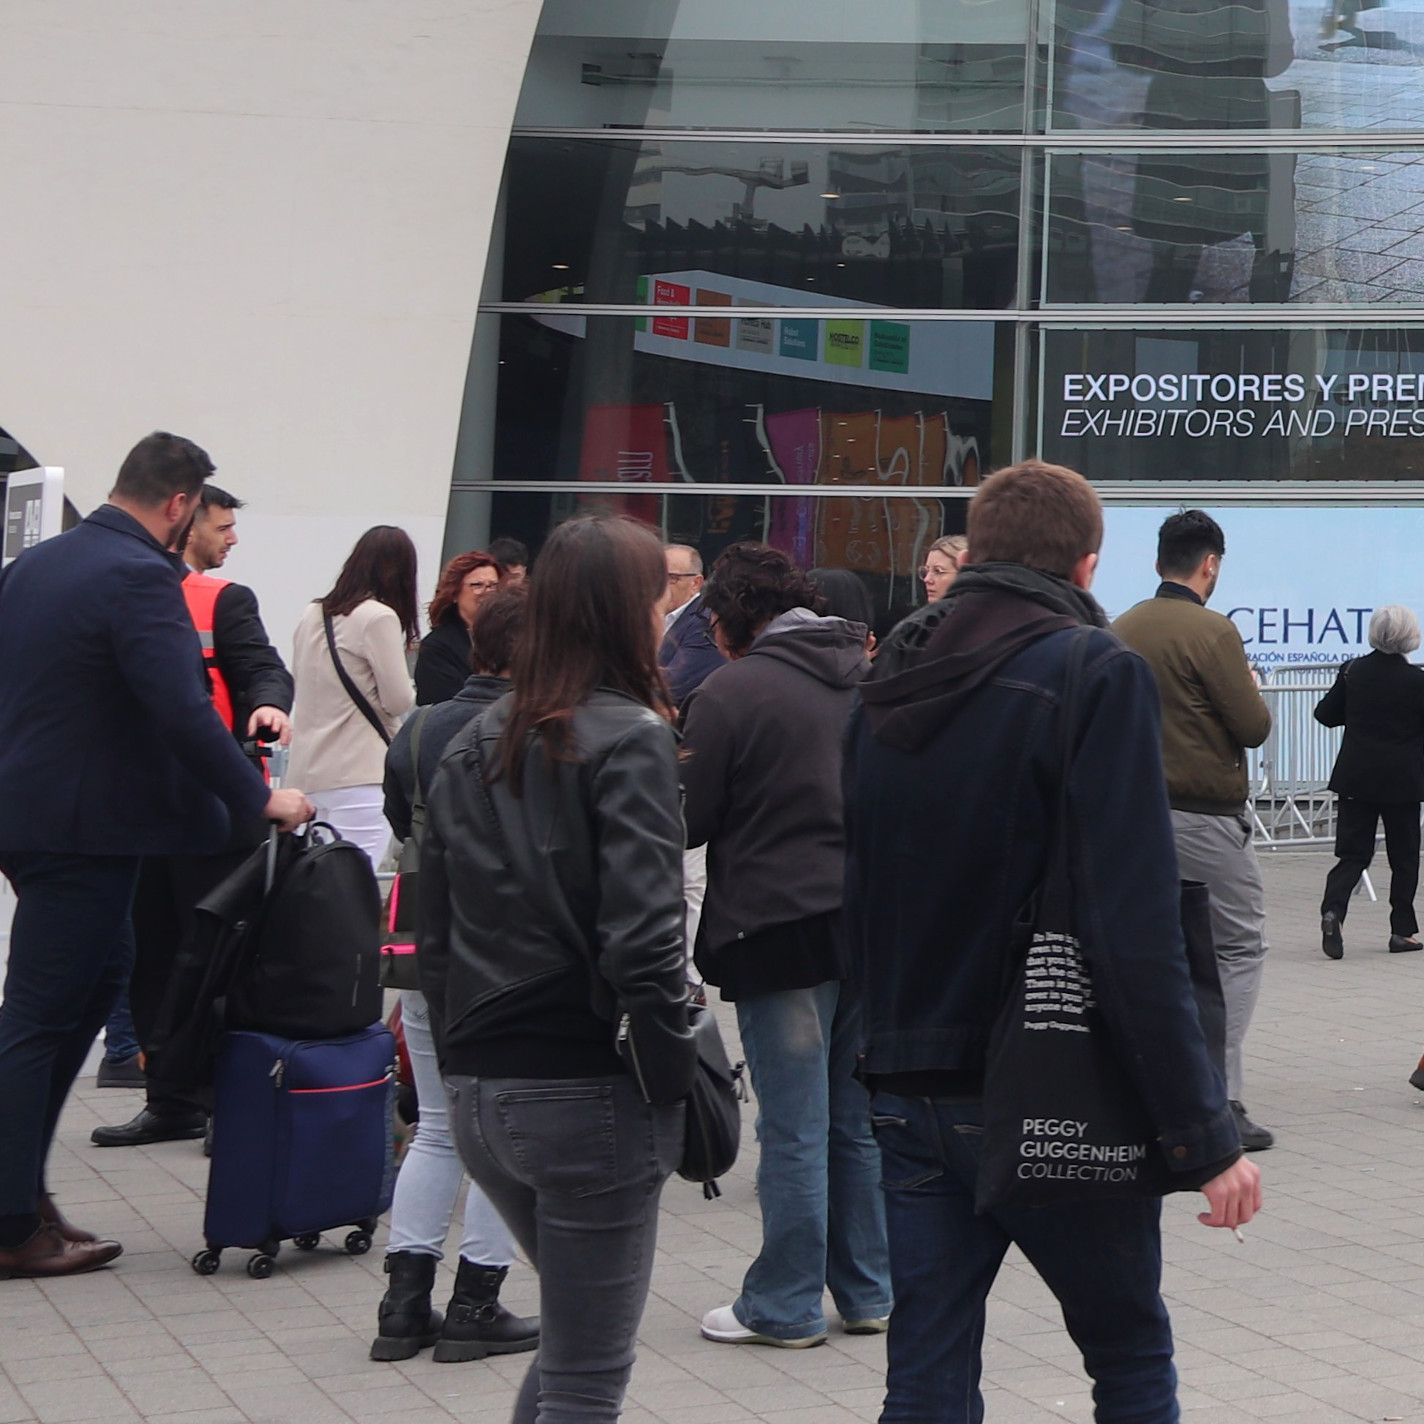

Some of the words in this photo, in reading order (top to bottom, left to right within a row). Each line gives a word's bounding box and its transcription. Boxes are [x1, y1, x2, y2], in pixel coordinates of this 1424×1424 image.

[1064, 373, 1305, 402] EXPOSITORES
[1317, 374, 1338, 402] Y
[1060, 408, 1256, 438] EXHIBITORS
[1263, 408, 1334, 437] AND
[1246, 651, 1285, 663] RACIÓN
[1288, 650, 1338, 663] ESPAÑOLA
[1023, 1119, 1088, 1137] PEGGY
[1020, 1141, 1146, 1162] GUGGENHEIM
[1017, 1163, 1138, 1182] COLLECTION
